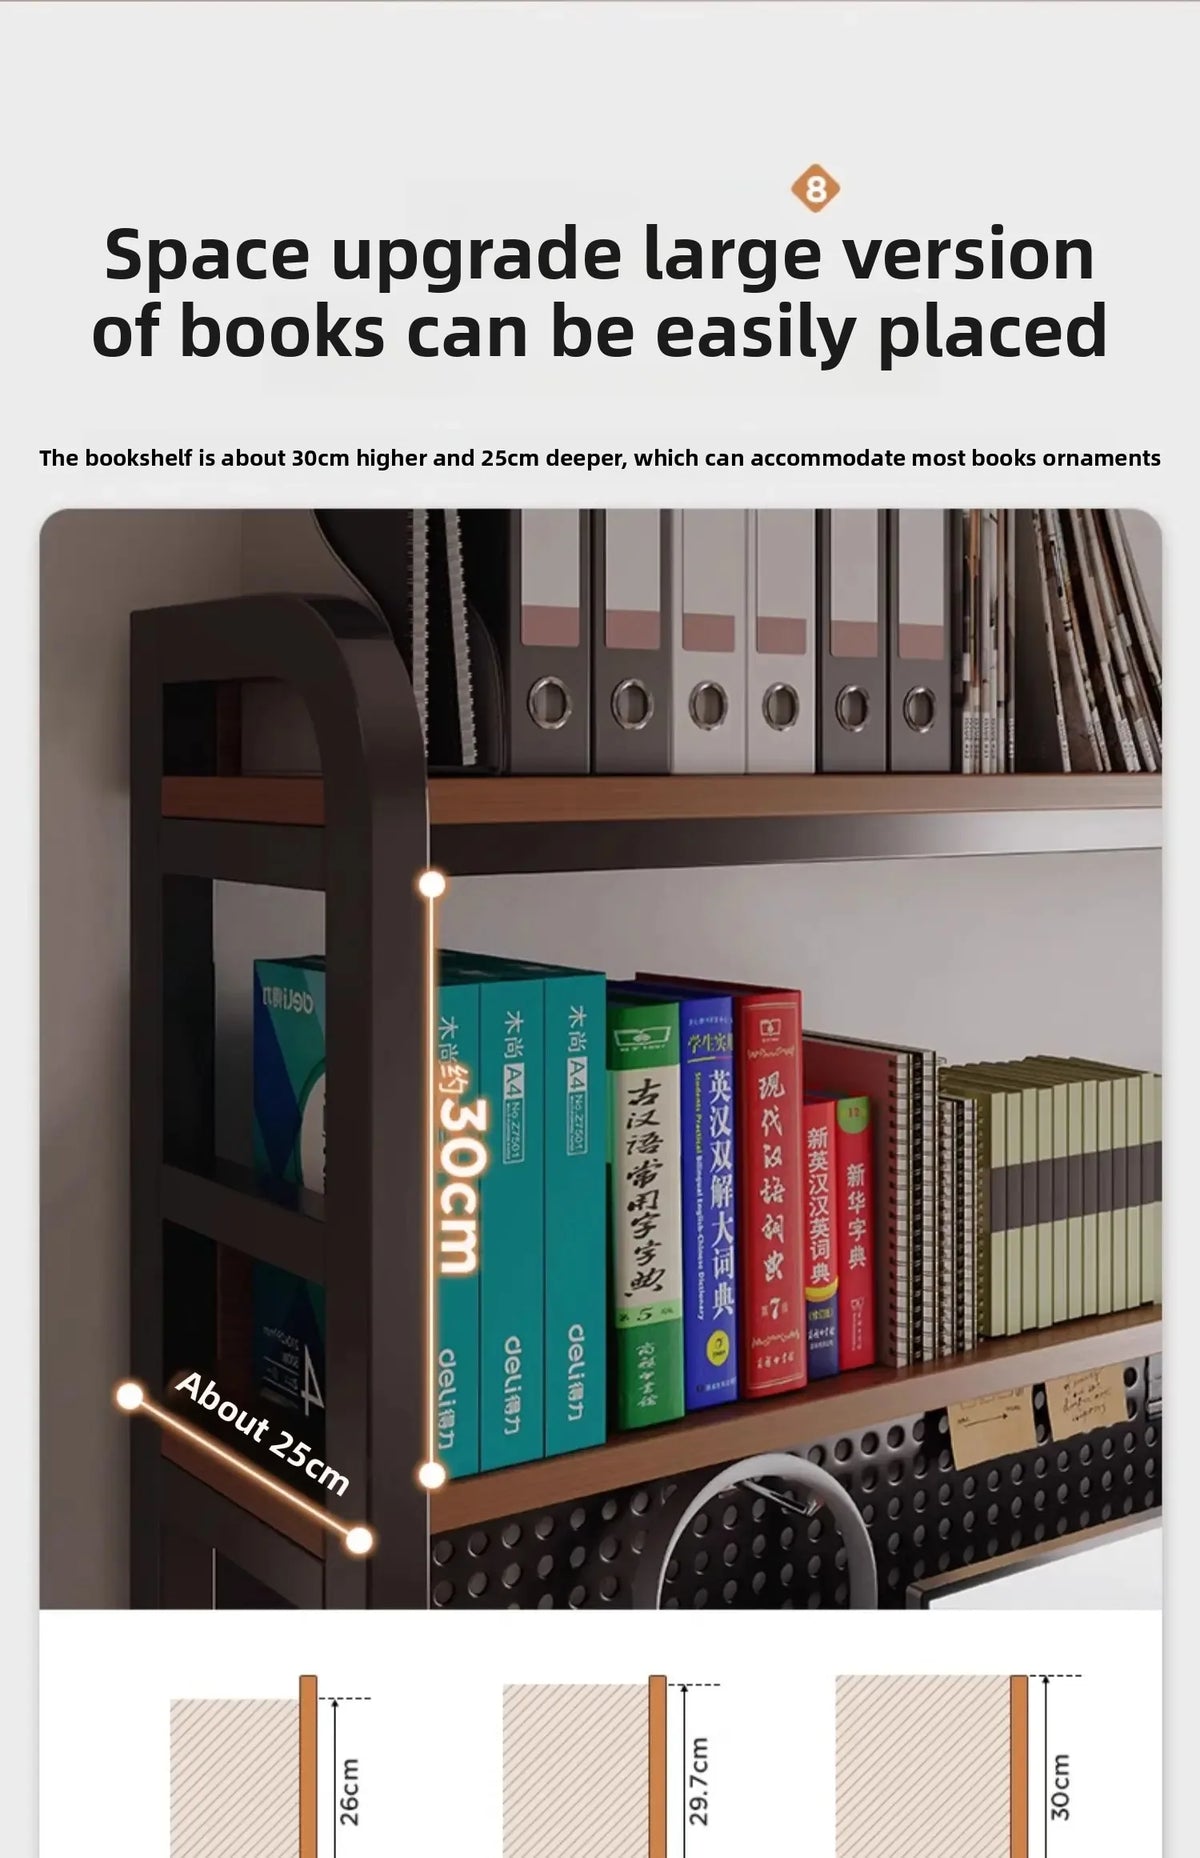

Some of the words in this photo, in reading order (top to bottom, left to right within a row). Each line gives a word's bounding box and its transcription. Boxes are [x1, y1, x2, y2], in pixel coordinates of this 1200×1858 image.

[504, 1010, 525, 1059] 木尚
[567, 1005, 588, 1053] 木尚
[506, 1066, 523, 1098] A4
[569, 1059, 586, 1090] A4
[624, 1078, 667, 1297] 古汉语常用字字典
[708, 1068, 735, 1321] 英汉双解大词典
[807, 1126, 831, 1285] 新英汉汉英词典
[846, 1162, 867, 1271] 新华字典
